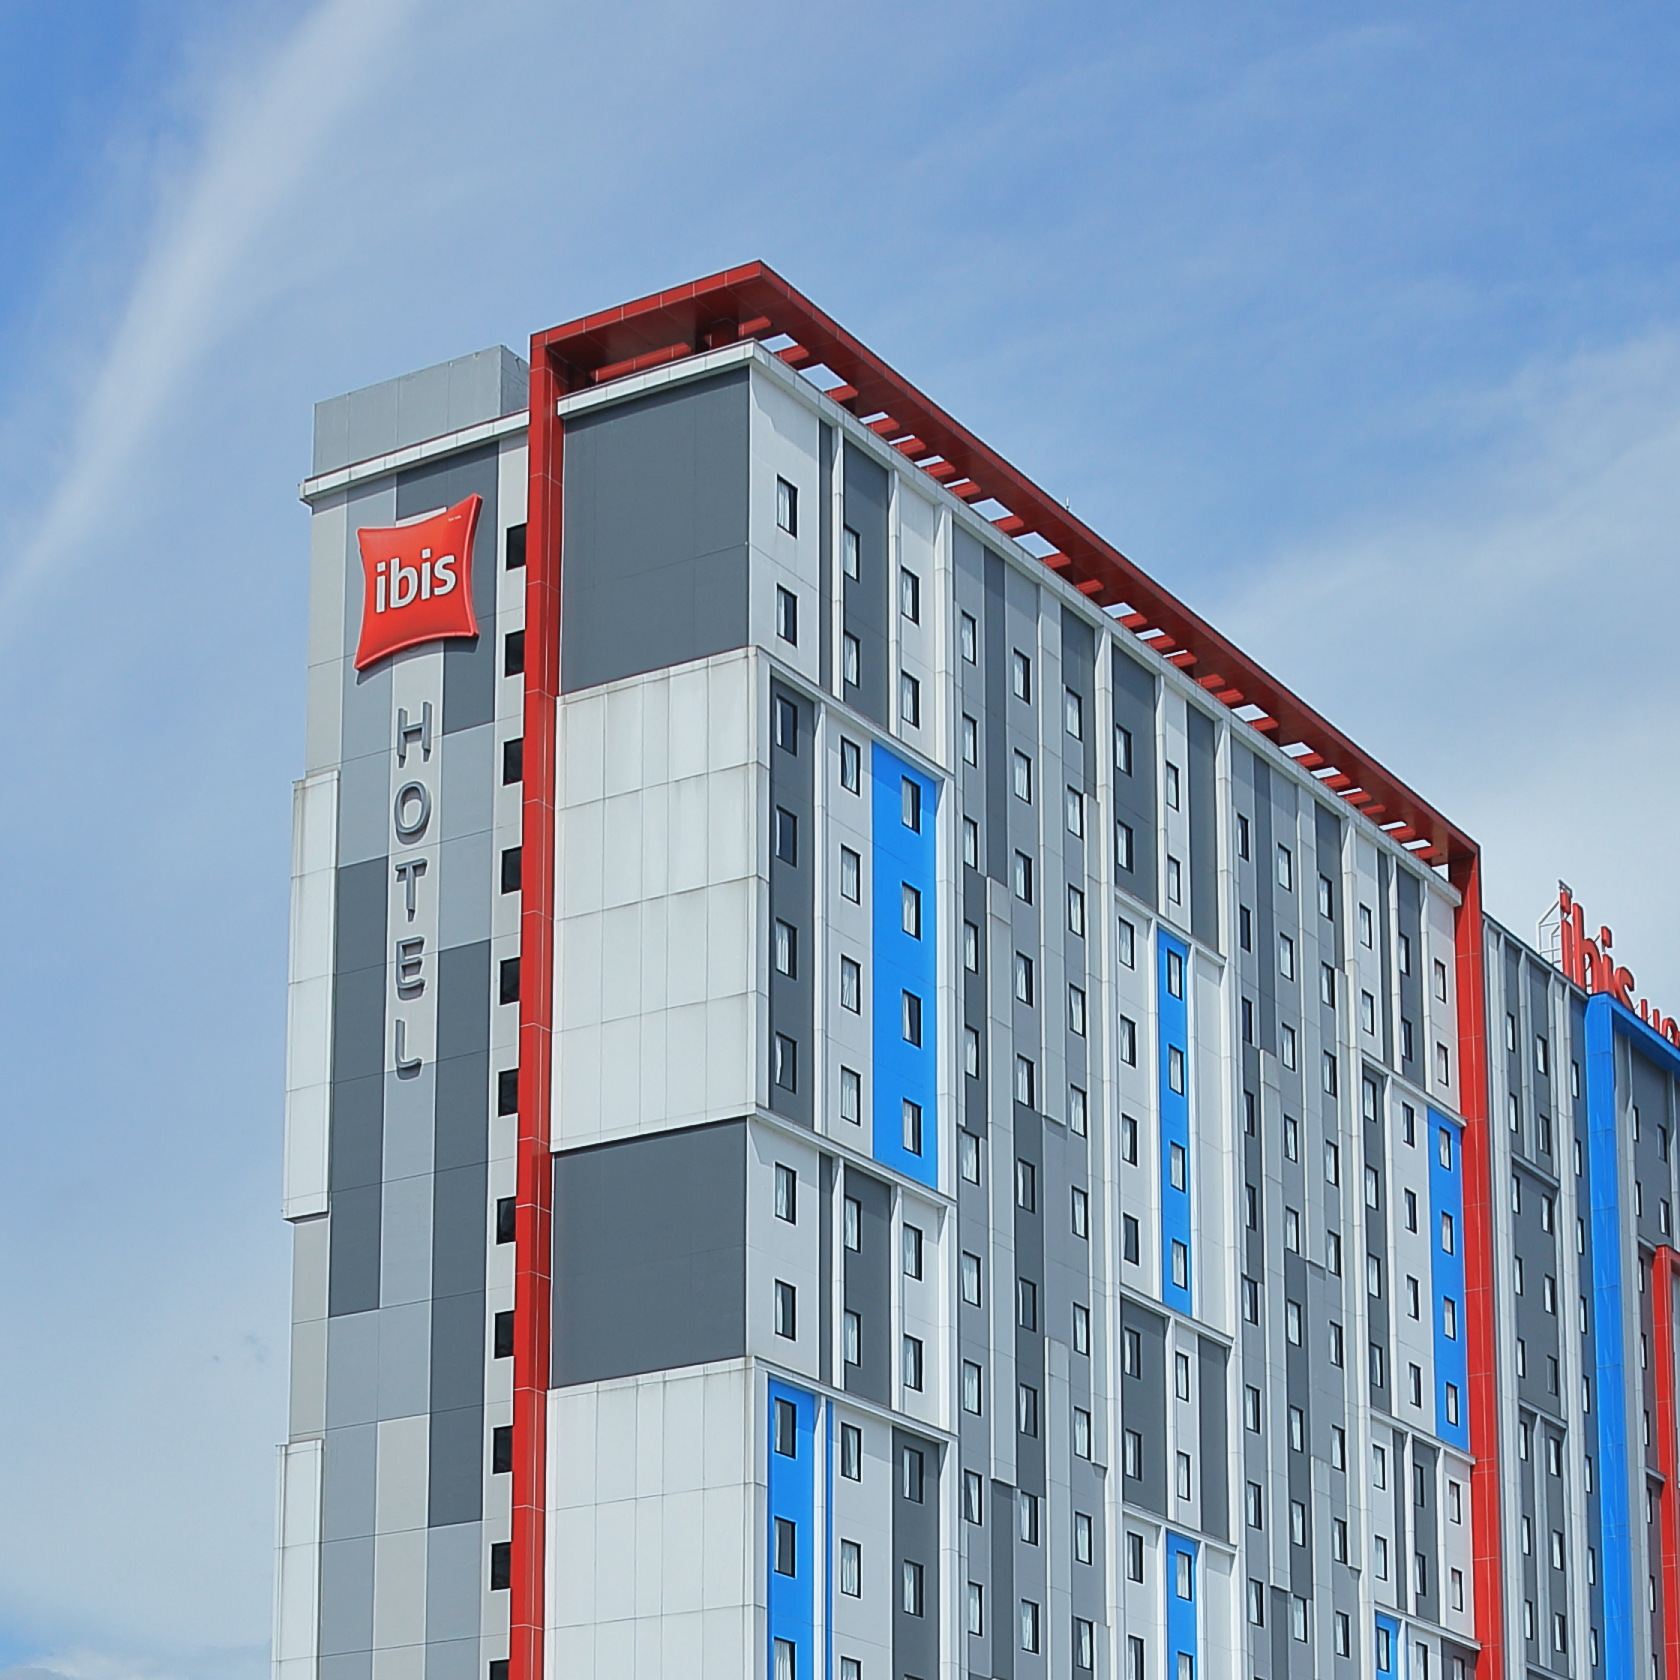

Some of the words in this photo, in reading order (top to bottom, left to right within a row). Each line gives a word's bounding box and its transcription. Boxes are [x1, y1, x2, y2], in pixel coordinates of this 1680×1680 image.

[376, 548, 457, 613] ibis
[394, 701, 432, 1079] HOTEL
[1559, 891, 1635, 1012] ibis
